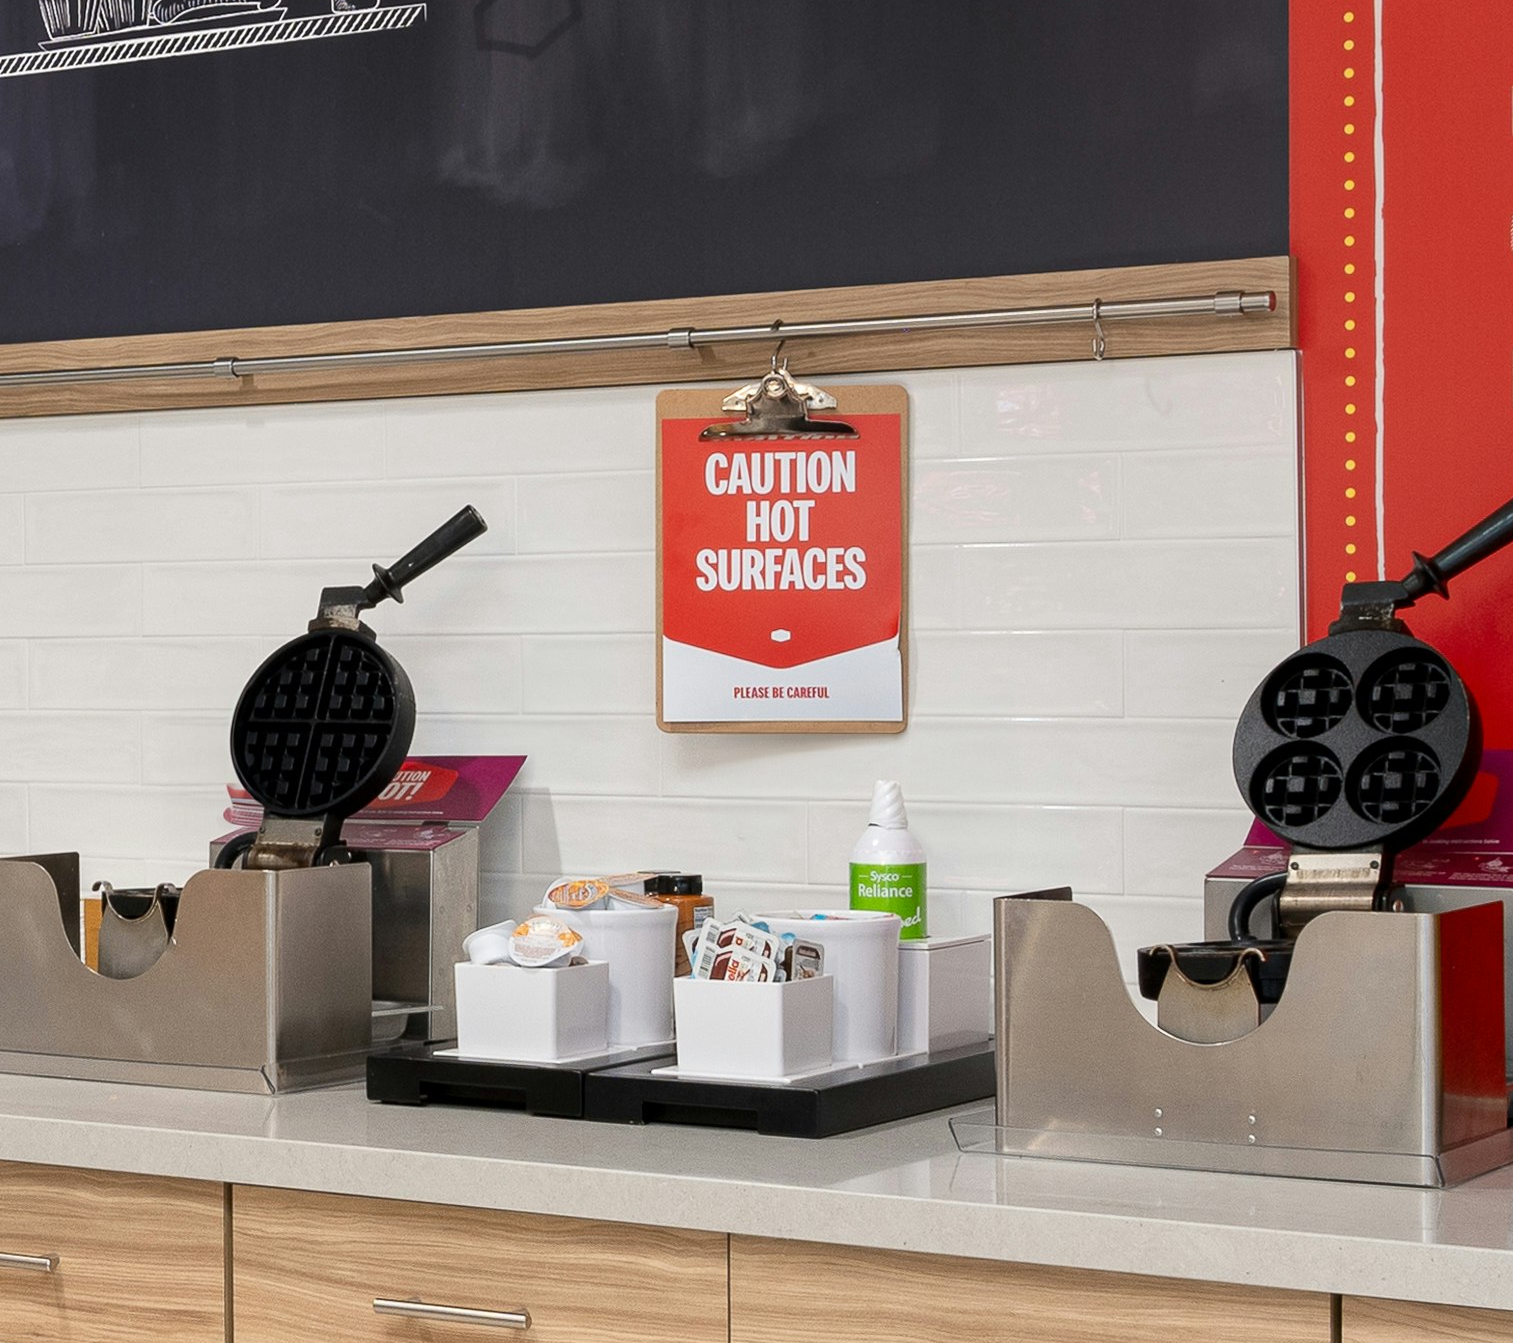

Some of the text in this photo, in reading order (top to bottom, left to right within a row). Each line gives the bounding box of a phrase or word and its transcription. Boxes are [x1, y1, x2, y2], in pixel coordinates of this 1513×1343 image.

[704, 450, 857, 496] CAUTION
[745, 499, 816, 543] HOT
[695, 546, 867, 592] SURFACES
[733, 686, 830, 699] PLEASE BE CAREFUL
[377, 782, 425, 801] OT!
[870, 870, 899, 883] Sysco
[858, 883, 913, 898] Reliance
[728, 959, 740, 981] ella
